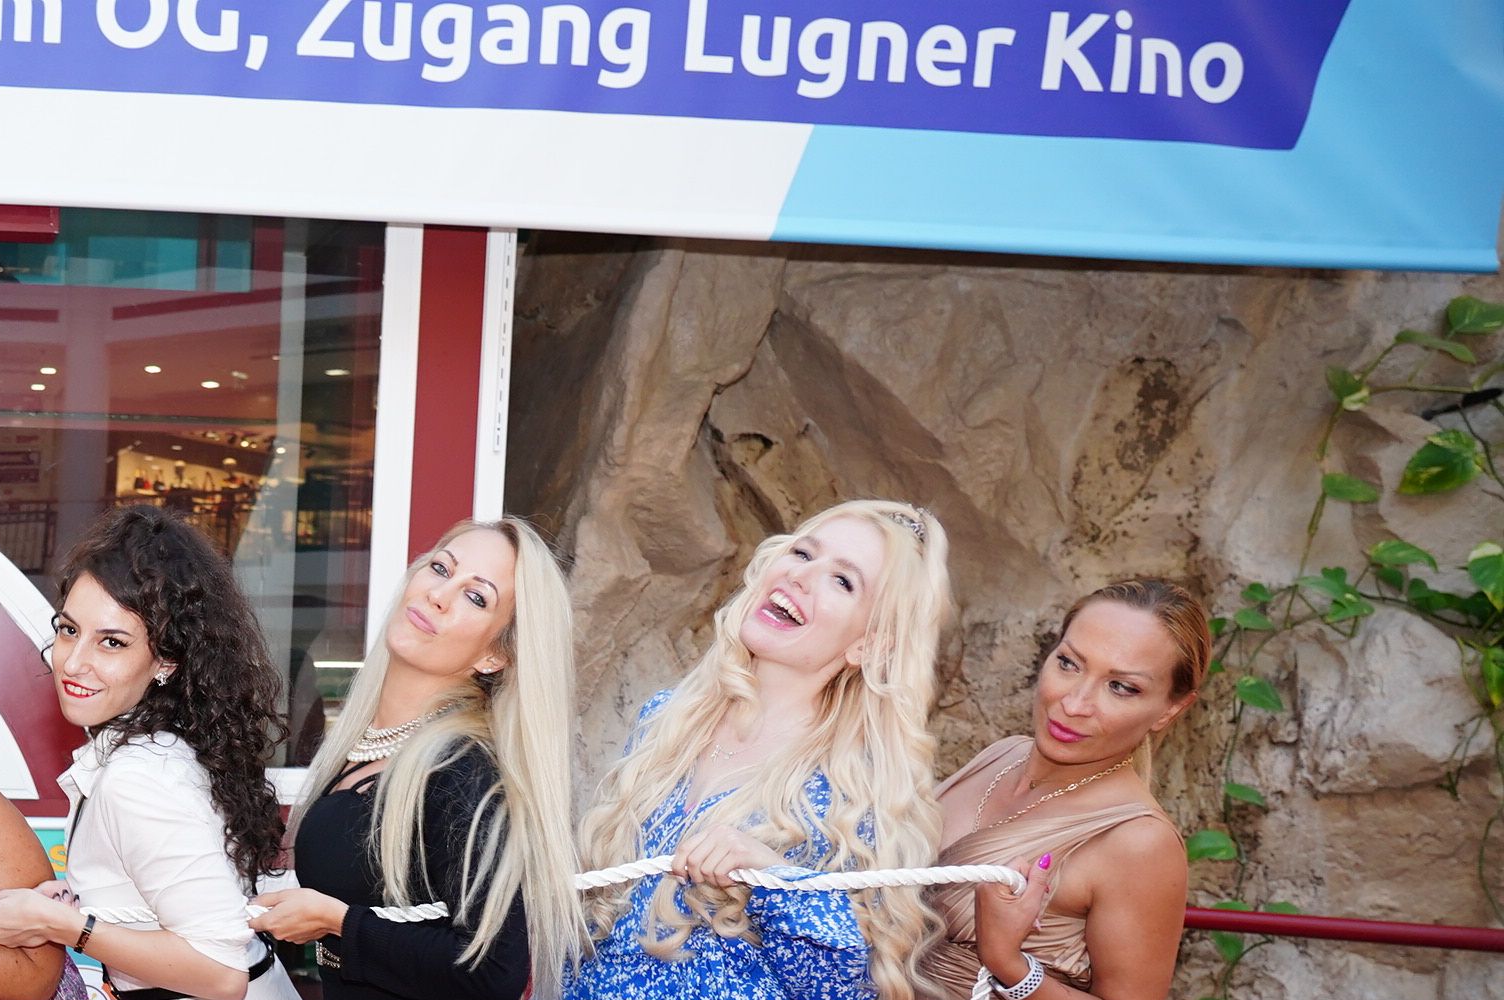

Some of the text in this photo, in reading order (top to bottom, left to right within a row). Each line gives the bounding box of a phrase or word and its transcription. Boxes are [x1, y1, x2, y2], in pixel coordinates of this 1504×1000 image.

[96, 0, 268, 71] OG,
[297, 0, 651, 90] Zugang
[684, 8, 1016, 99] Lugner
[1041, 9, 1245, 104] Kino
